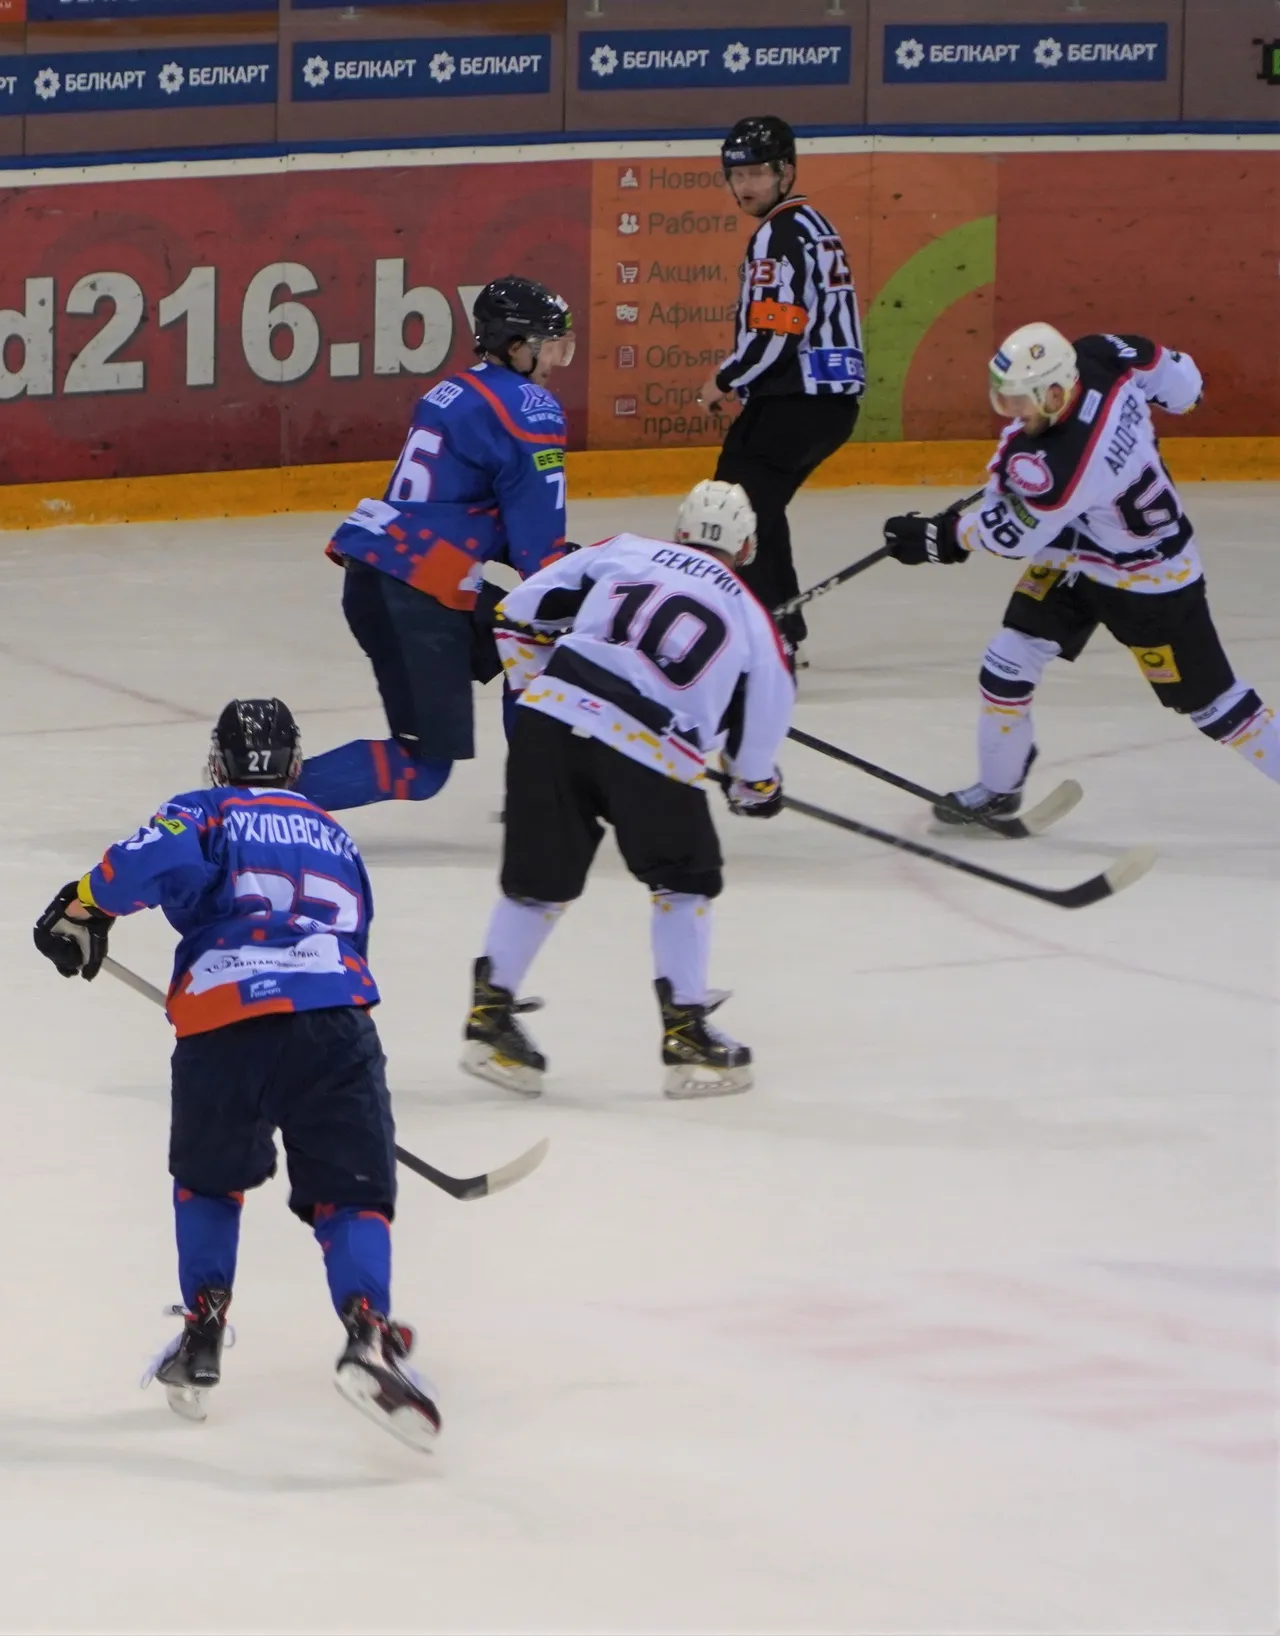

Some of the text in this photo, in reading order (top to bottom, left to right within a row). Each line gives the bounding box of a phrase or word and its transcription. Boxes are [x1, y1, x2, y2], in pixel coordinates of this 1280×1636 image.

[623, 45, 842, 70] БЕЛКАРТ БЕЛКАРТ
[929, 42, 1158, 64] БЕЛКАРТ БЕЛКАРТ
[65, 64, 269, 92] БЕЛКАРТ БЕЛКАРТ
[334, 54, 542, 80] БЕЛКАРТ БЕЛКАРТ
[647, 209, 738, 235] Работа
[700, 521, 722, 542] 10
[980, 499, 1025, 550] 66
[608, 581, 727, 690] 10
[247, 749, 273, 773] 27
